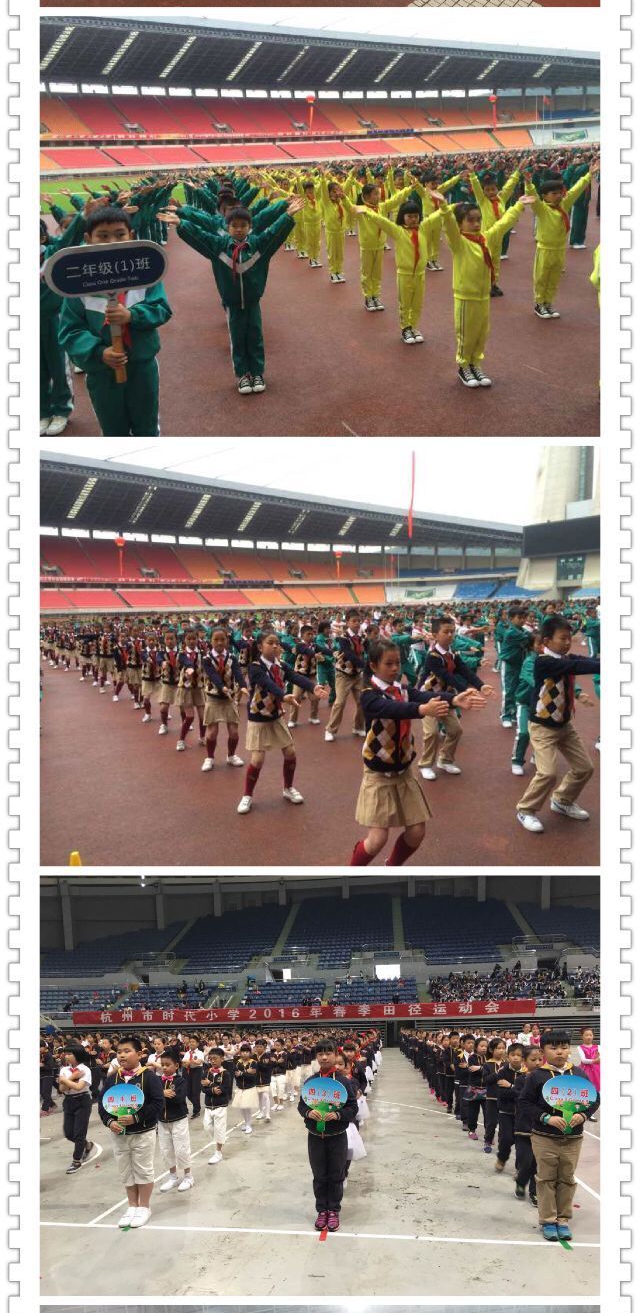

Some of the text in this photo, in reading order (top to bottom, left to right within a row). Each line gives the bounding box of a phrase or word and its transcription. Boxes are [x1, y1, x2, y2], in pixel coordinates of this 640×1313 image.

[100, 1001, 500, 1024] 杭州市时代小学2016年春季田径运动会
